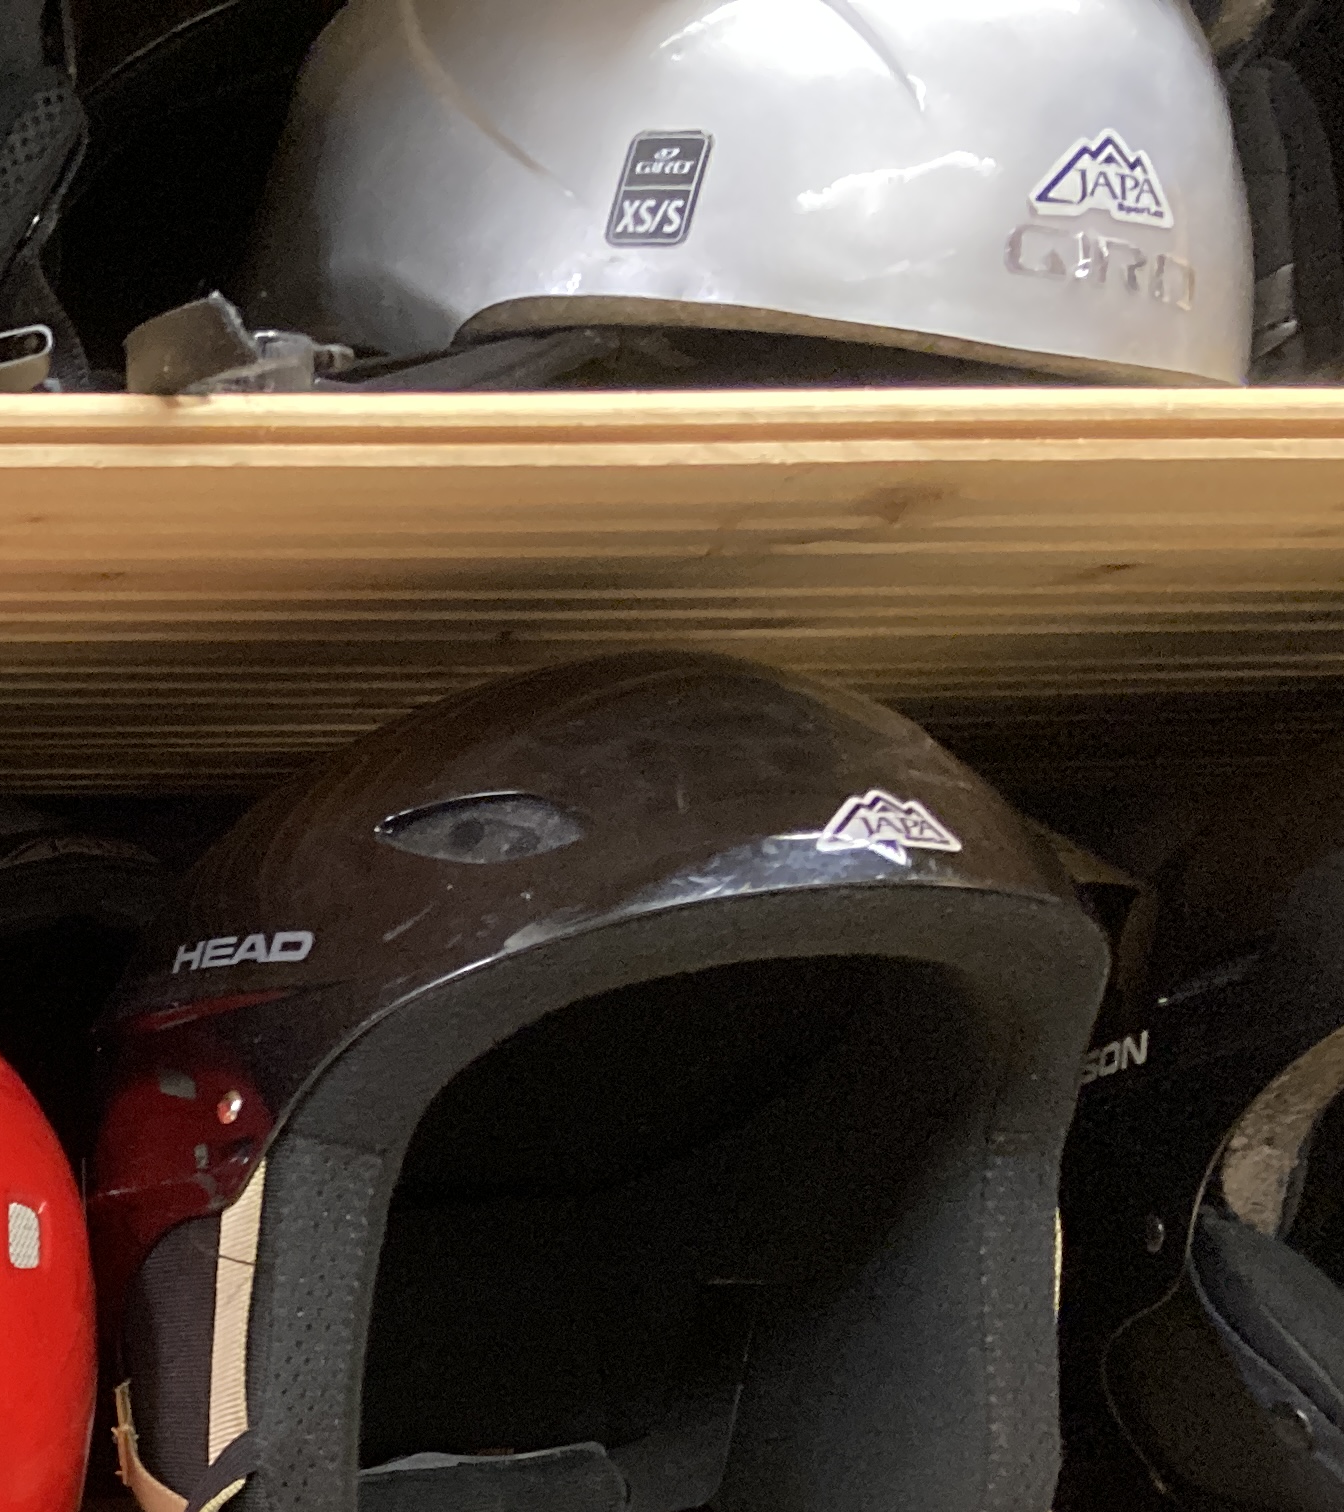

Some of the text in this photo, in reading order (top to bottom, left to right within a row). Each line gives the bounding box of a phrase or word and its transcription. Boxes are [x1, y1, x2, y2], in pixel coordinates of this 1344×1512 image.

[1074, 168, 1162, 208] JAPA
[615, 197, 685, 234] XS/S
[853, 816, 946, 839] JAPA
[172, 930, 314, 975] HEAD
